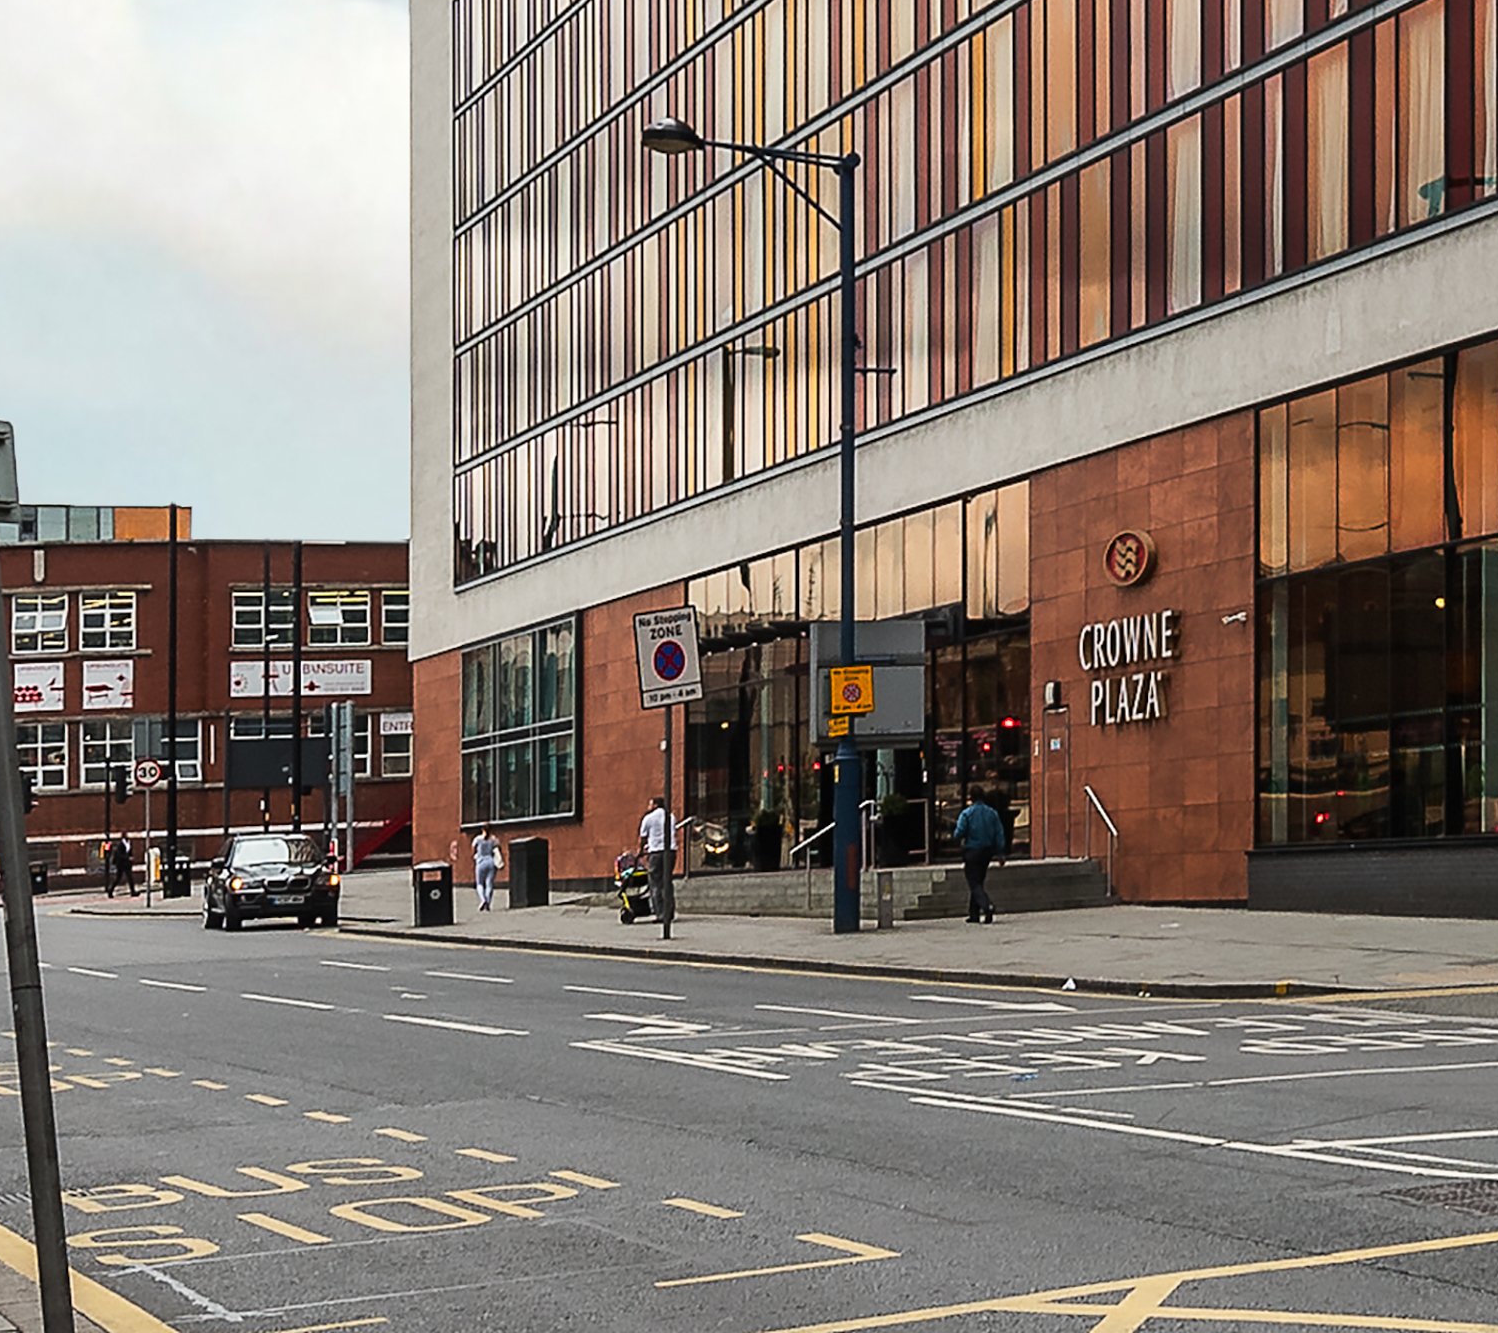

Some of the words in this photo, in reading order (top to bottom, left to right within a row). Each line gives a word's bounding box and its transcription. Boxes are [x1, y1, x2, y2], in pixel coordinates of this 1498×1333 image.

[650, 625, 682, 640] ZONE
[1079, 609, 1172, 671] CROWNE
[282, 663, 365, 675] UBANSUITE
[1091, 671, 1160, 726] PLAZA
[139, 767, 158, 778] 30
[63, 1158, 424, 1213] BUS
